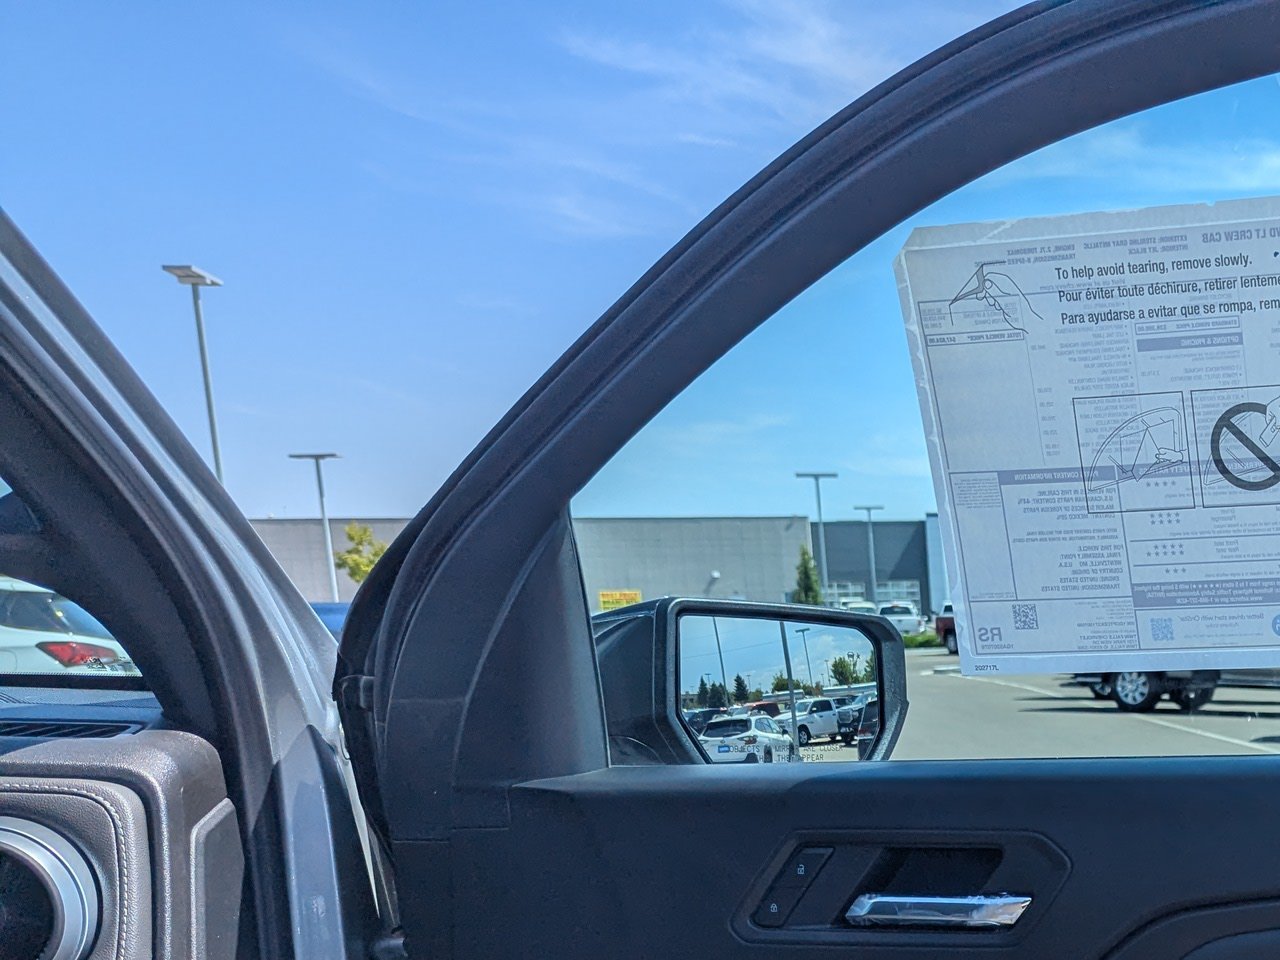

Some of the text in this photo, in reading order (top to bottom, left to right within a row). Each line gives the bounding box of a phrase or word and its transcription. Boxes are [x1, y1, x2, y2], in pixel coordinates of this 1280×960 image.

[1055, 252, 1252, 280] To help avoid tearing, remove slowly.
[1058, 290, 1082, 302] Pour
[1085, 287, 1114, 300] éviter
[1118, 286, 1145, 297] toute
[1148, 282, 1201, 295] déchirure,
[1204, 278, 1237, 292] retirer
[1061, 312, 1085, 325] Para
[1088, 309, 1135, 324] ayudarse
[1139, 309, 1145, 319] a
[1148, 305, 1177, 318] evitar
[1181, 305, 1200, 318] que
[1203, 303, 1215, 314] se
[1219, 299, 1256, 314] rompa,
[729, 745, 760, 753] OBJECTS
